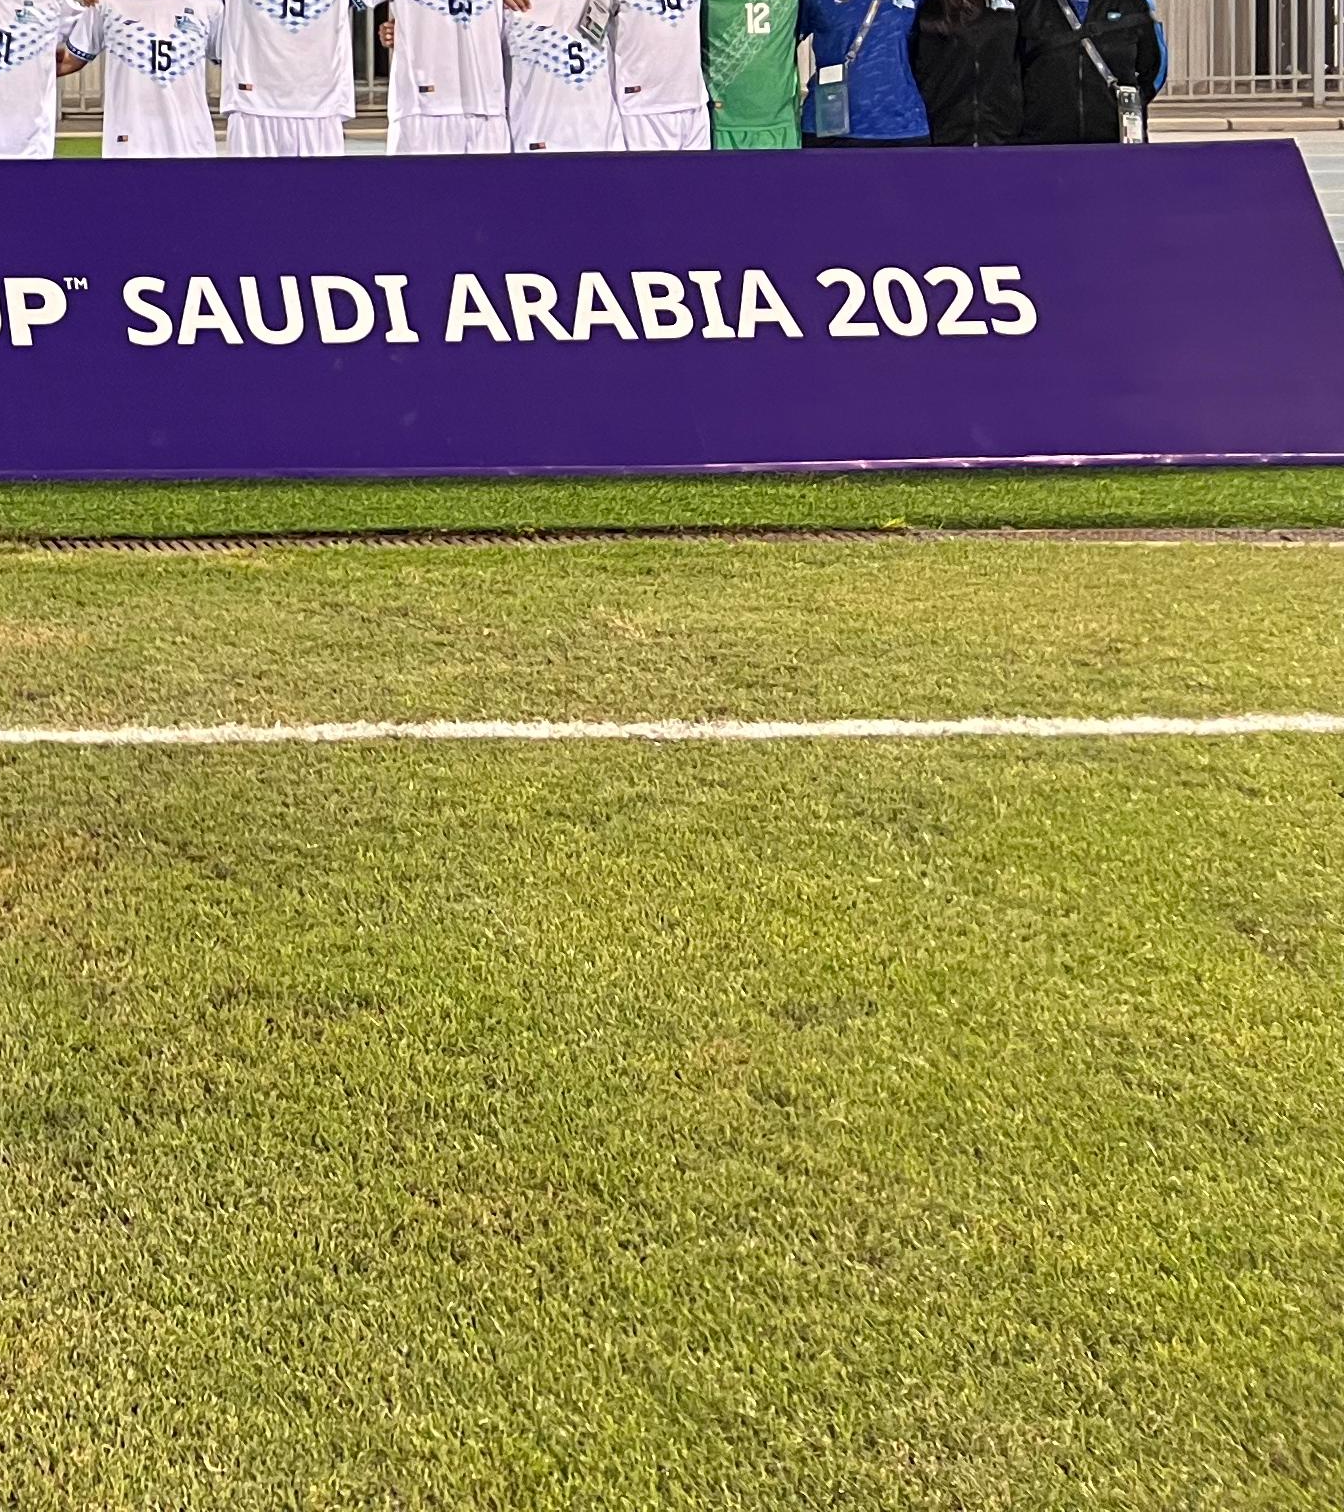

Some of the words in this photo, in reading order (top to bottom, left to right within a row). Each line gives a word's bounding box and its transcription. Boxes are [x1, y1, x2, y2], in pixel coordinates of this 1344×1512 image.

[745, 2, 770, 34] 12
[150, 39, 174, 72] 15
[568, 42, 585, 75] 5
[122, 275, 420, 346] SAUDI
[444, 269, 804, 342] ARABIA
[816, 265, 1037, 337] 2025
